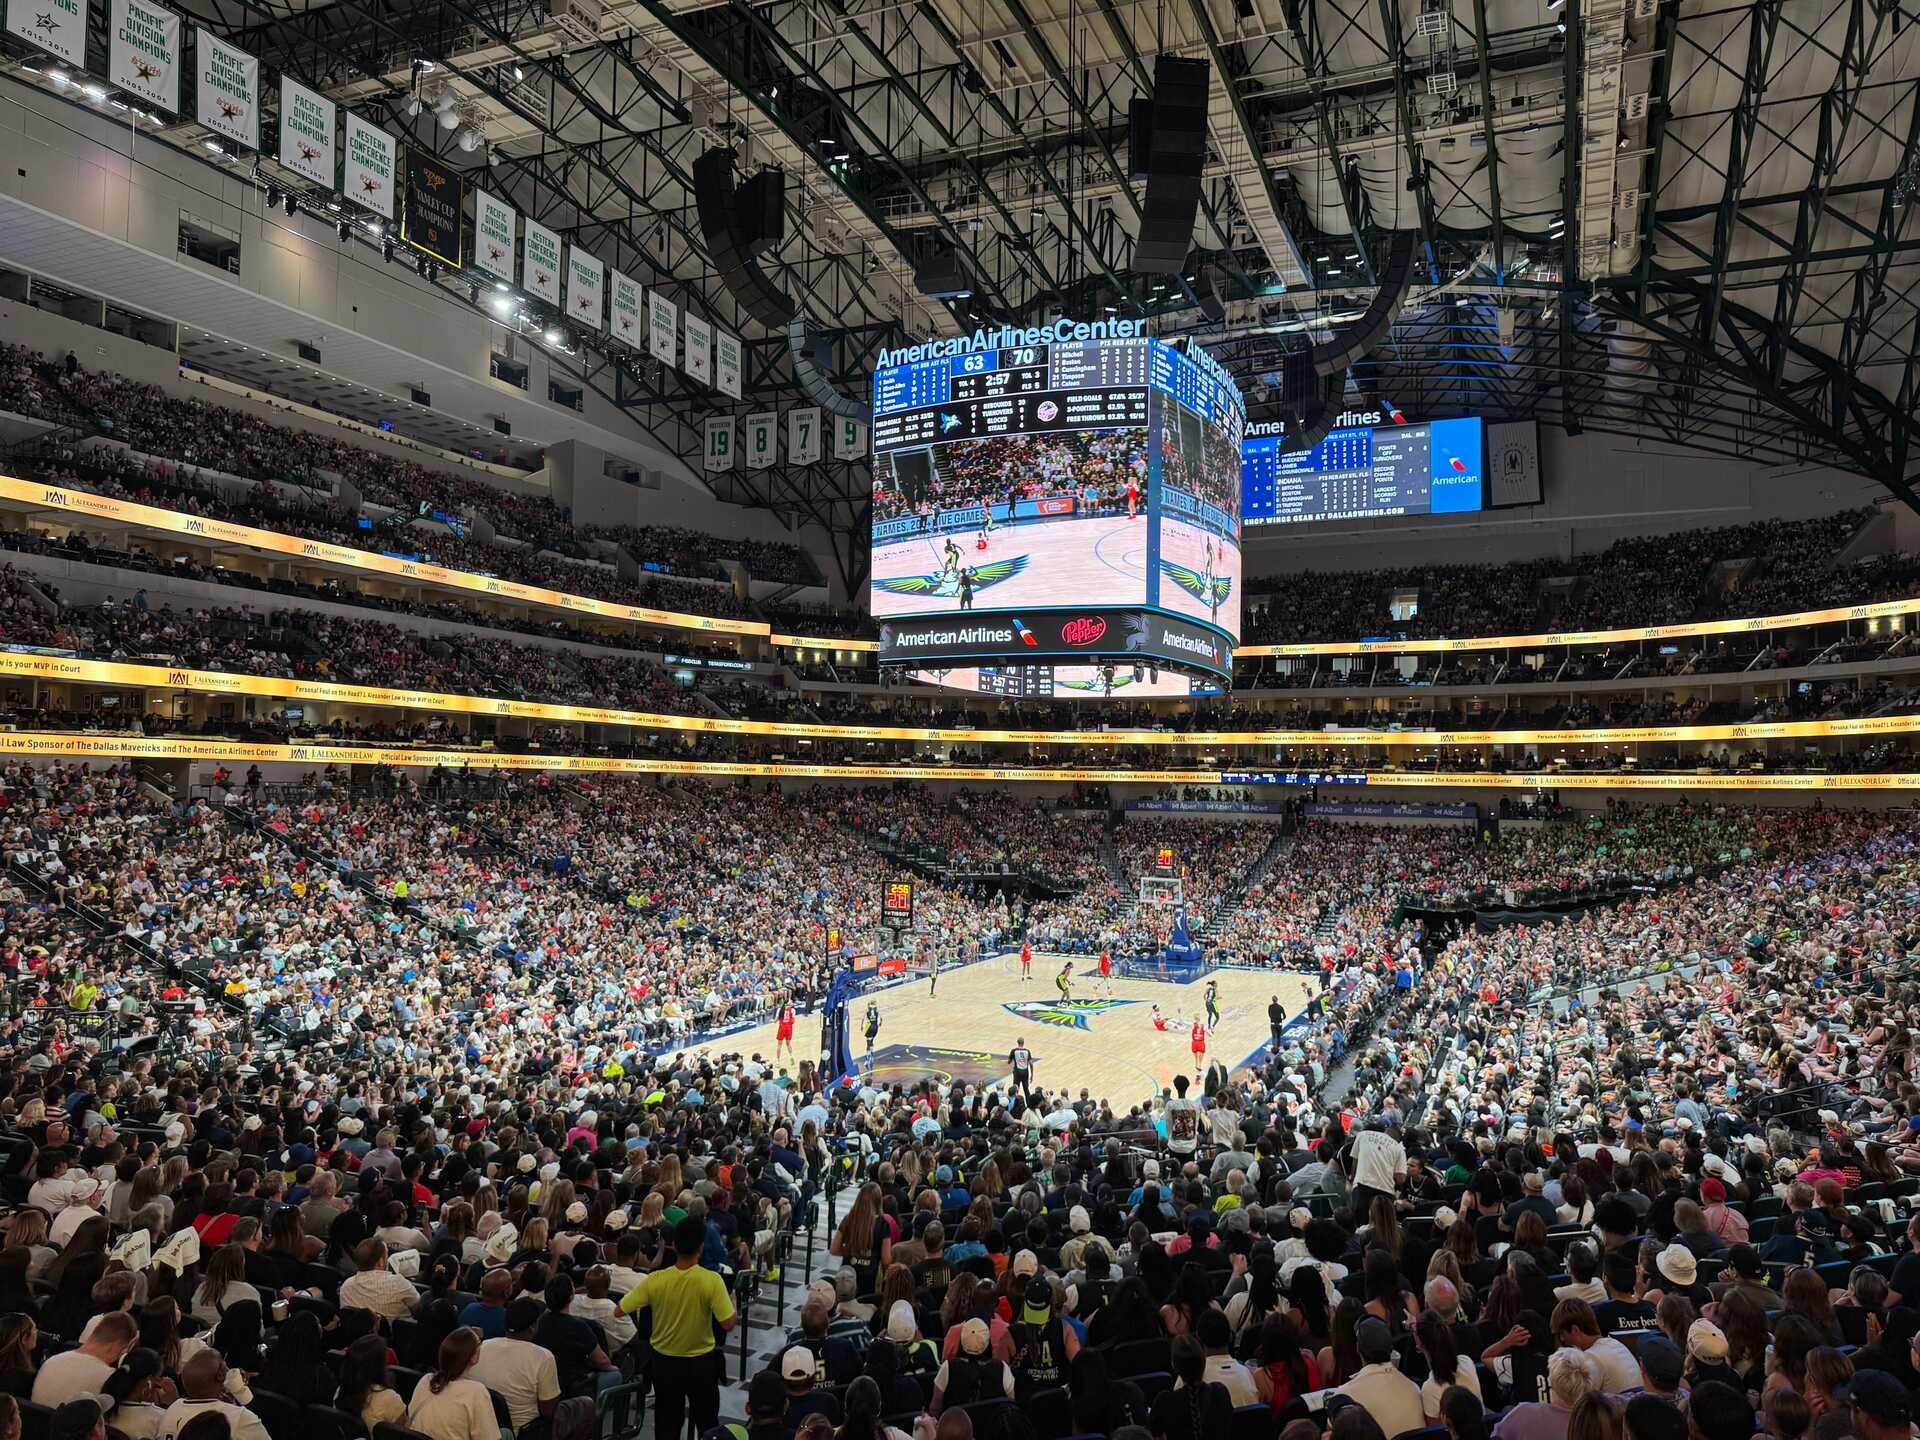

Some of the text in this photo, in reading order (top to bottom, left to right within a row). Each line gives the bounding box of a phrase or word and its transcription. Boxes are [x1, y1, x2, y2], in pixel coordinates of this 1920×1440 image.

[129, 3, 164, 31] PACIFIC
[126, 17, 166, 47] DIVISION
[119, 28, 171, 65] CHAMPIONS
[212, 47, 244, 74] PACIFIC
[211, 61, 246, 87] DIVISION
[205, 72, 251, 104] CHAMPIONS
[295, 94, 323, 117] PACIFIC
[294, 106, 324, 132] DIVISION
[288, 116, 328, 146] CHAMPIONS
[356, 128, 385, 152] WESTERN
[350, 137, 391, 168] CONFERENCE
[352, 152, 389, 178] CHAMPIONS
[481, 223, 511, 247] CHAMPIONS
[485, 214, 507, 234] DIVISION
[528, 239, 557, 260] CONFERENCE
[529, 250, 556, 272] CHAMPIONS
[965, 355, 984, 371] 63
[1013, 349, 1034, 365] 70
[985, 373, 1010, 386] 2:57
[710, 430, 728, 456] 19
[756, 427, 767, 452] 8
[799, 424, 810, 449] 7
[845, 422, 857, 445] 9
[1432, 475, 1478, 485] American
[876, 510, 985, 536] NAMES, GAMES
[1244, 518, 1264, 526] SHOP
[1293, 514, 1313, 522] GEAR
[1328, 507, 1405, 519] DALLASWINGS.COM
[896, 628, 1012, 646] American Airlines
[1066, 616, 1104, 643] Dr Pepper
[1163, 630, 1213, 657] American Airlines
[6, 659, 12, 667] is
[34, 662, 50, 670] MVP
[52, 663, 58, 671] in
[60, 664, 80, 673] Court
[7, 739, 278, 757] Law Sponsor of The Dallas Mavericks and The American Airlines Center
[1363, 807, 1382, 815] Albert
[1443, 808, 1463, 816] Albert
[1157, 855, 1171, 865] 20
[891, 883, 909, 894] 2:56
[857, 1258, 871, 1266] AT&T
[1804, 1251, 1815, 1269] 5
[1618, 1316, 1640, 1328] Ever
